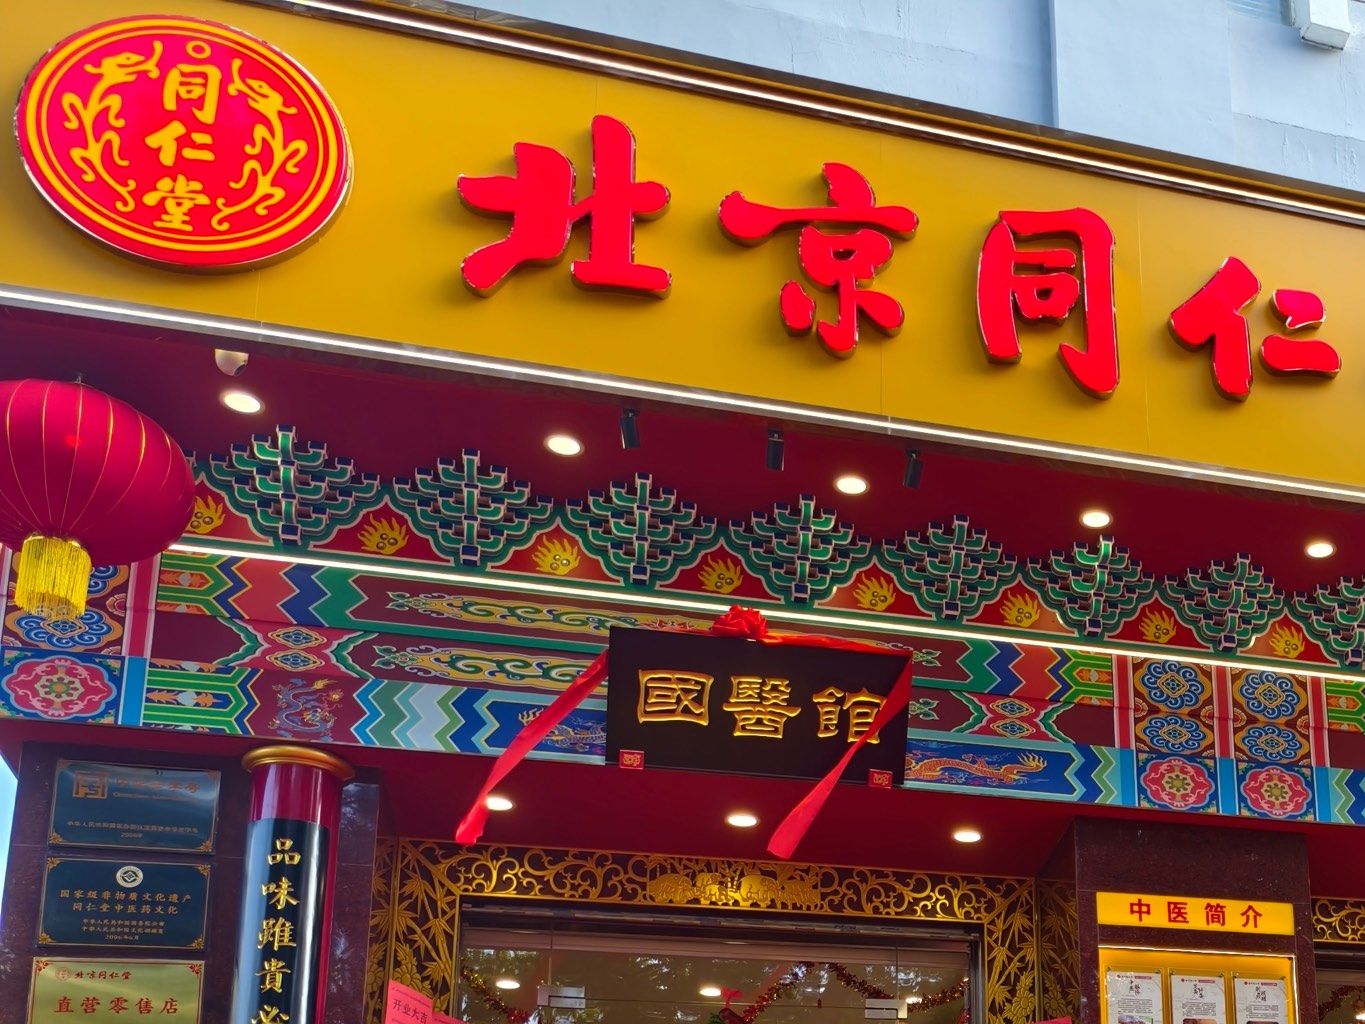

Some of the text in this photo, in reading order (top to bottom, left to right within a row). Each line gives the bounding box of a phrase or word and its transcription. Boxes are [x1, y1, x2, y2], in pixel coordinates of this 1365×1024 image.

[144, 62, 221, 232] 同仁堂
[1129, 898, 1263, 929] 中医简介
[74, 969, 131, 981] 北京同仁堂
[54, 996, 179, 1015] 直营零售店
[392, 998, 429, 1024] 开业大吉
